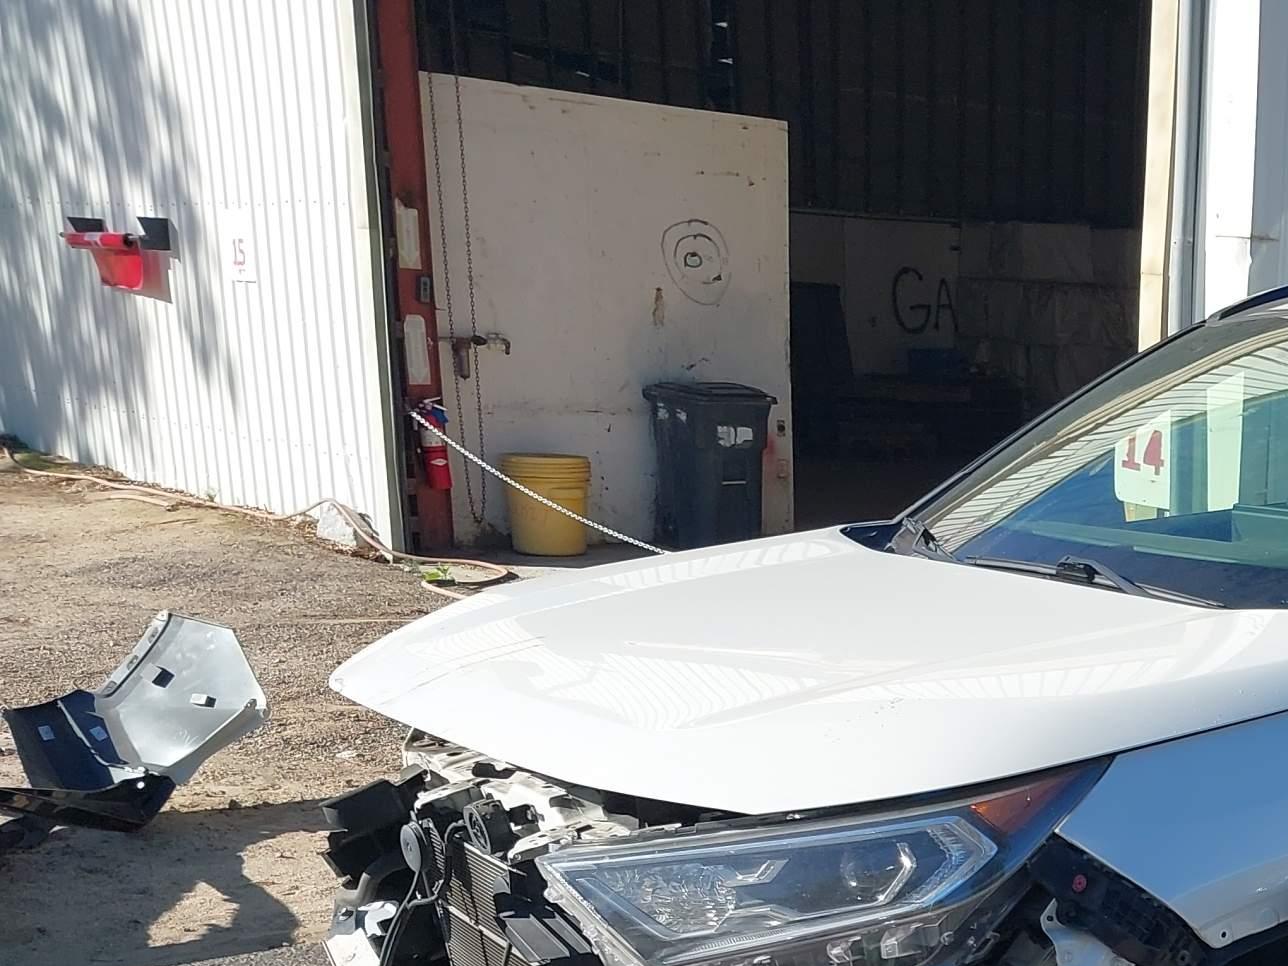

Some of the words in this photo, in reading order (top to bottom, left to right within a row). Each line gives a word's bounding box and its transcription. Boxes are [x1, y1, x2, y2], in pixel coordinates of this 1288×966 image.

[232, 238, 246, 266] 15
[891, 266, 960, 335] GA
[1121, 429, 1165, 476] 14
